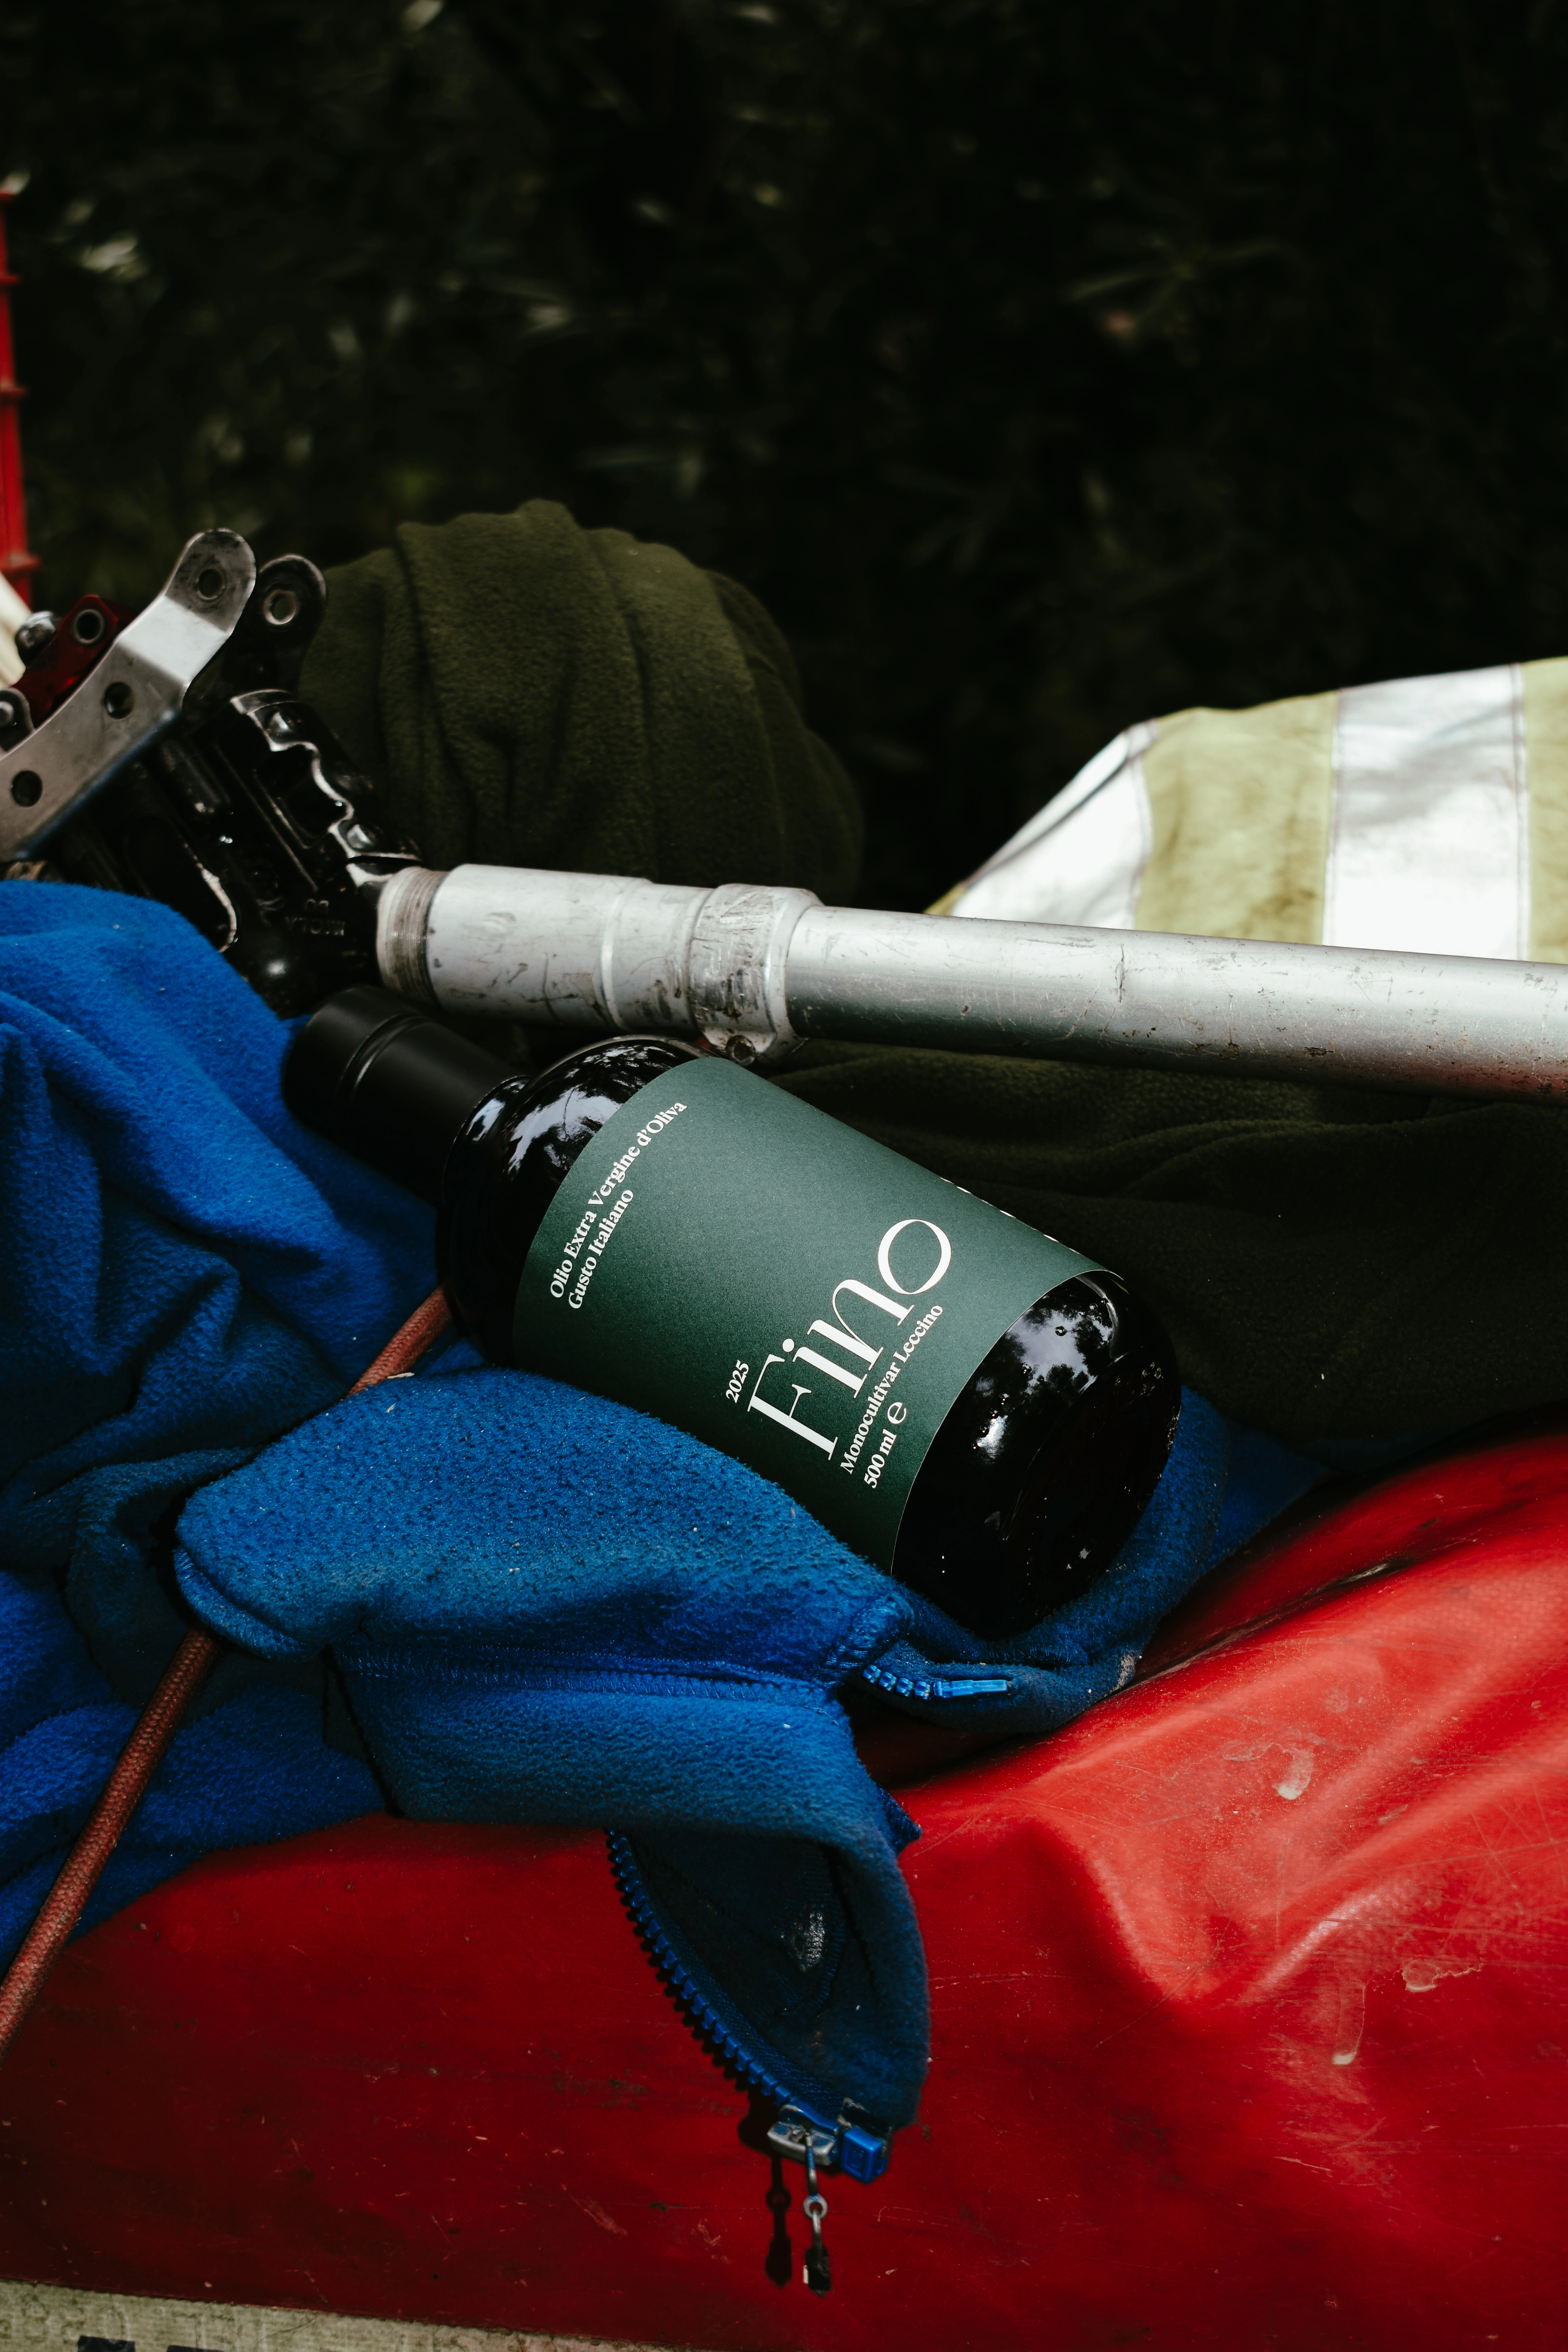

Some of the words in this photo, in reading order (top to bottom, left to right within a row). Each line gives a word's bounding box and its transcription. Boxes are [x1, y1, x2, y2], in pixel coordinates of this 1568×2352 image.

[550, 1259, 572, 1298] Olio
[564, 1211, 597, 1259] Extra
[588, 1146, 641, 1206] Vergine
[636, 1102, 687, 1146] d'Oliva
[569, 1257, 597, 1309] Gusto
[588, 1189, 633, 1256] Italiano
[726, 1359, 749, 1403] 2025
[747, 1219, 953, 1461] Fino
[840, 1362, 901, 1475] Monocultivar
[892, 1305, 944, 1364] Leccino
[864, 1454, 885, 1488] 500
[879, 1428, 897, 1456] ml
